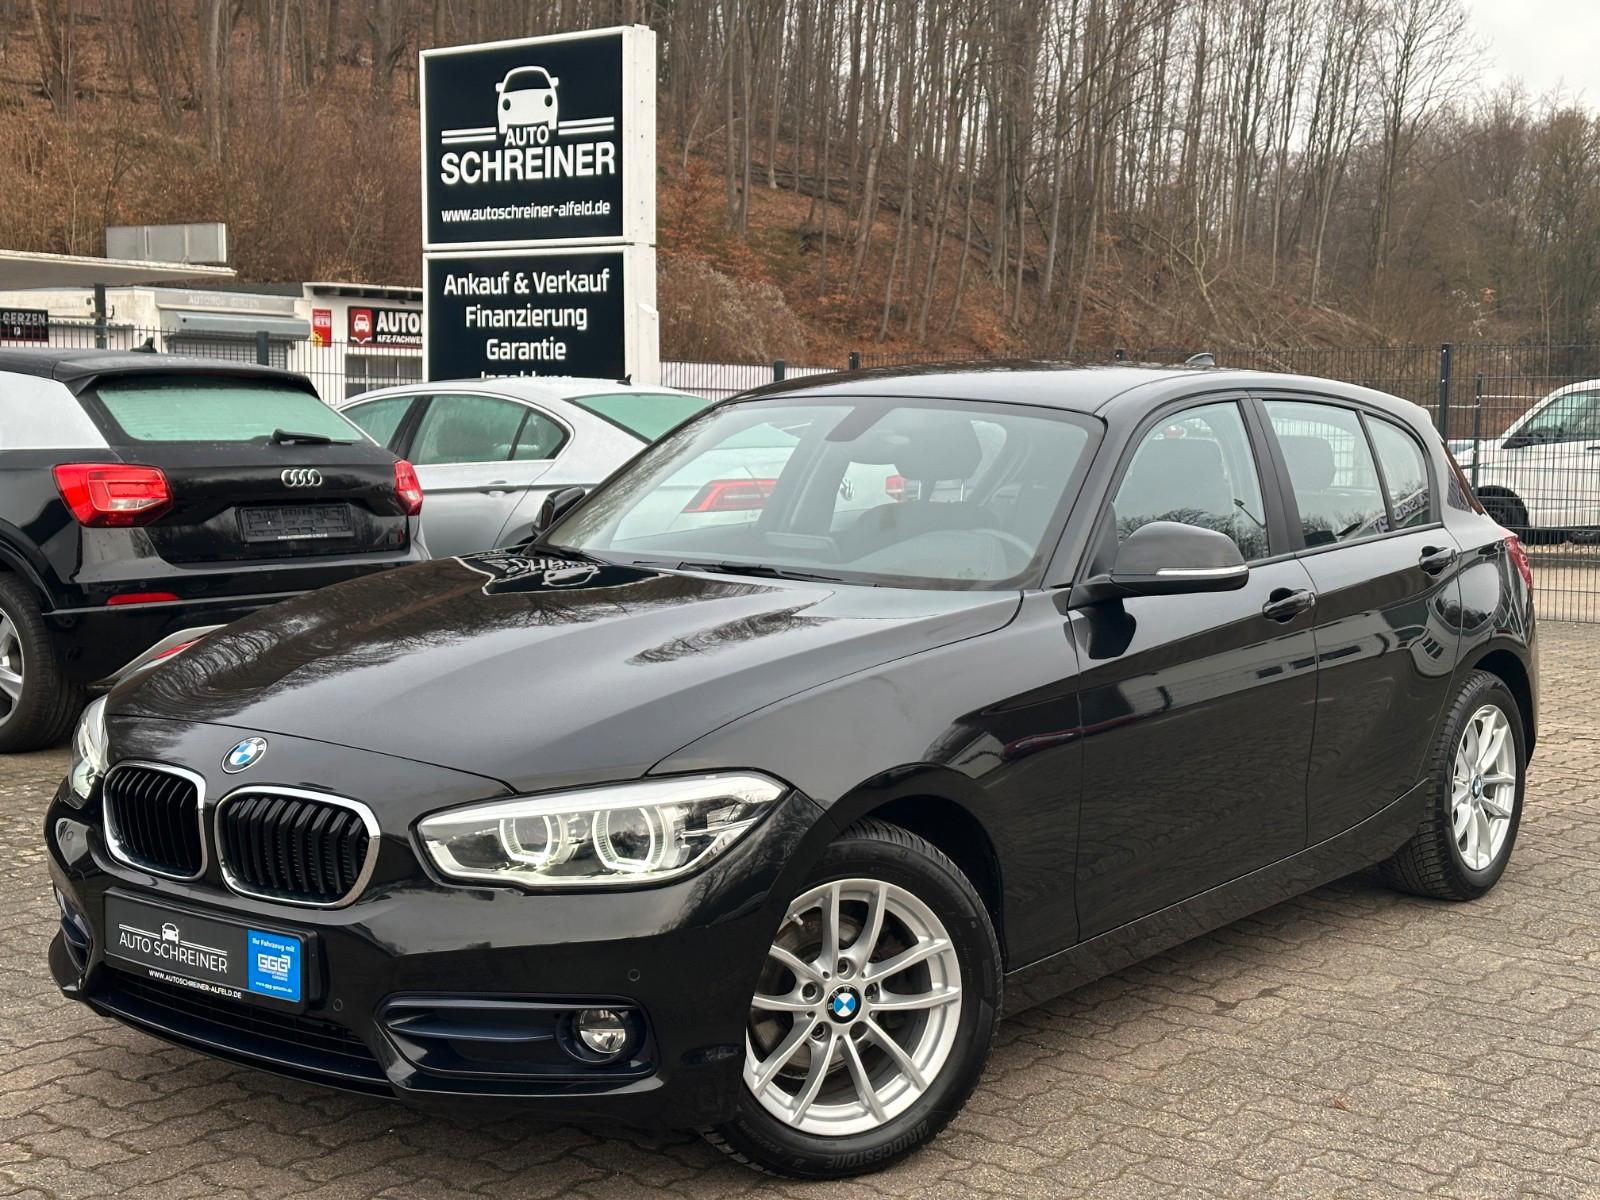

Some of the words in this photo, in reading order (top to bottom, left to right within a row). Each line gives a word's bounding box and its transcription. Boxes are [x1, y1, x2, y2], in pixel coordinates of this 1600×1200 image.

[504, 124, 550, 147] AUTO
[440, 140, 616, 186] SCHREINER
[441, 200, 611, 223] www.autoschreiner-alfeld.de
[443, 270, 510, 296] Ankauf
[513, 270, 530, 295] &
[532, 268, 610, 294] Verkauf
[2, 311, 46, 326] GERZEN
[376, 310, 423, 334] AUTO
[465, 304, 588, 332] Finanzierung
[376, 334, 423, 345] KFZ-FACHWE
[486, 338, 567, 361] Garantie
[119, 931, 152, 954] AUTO
[153, 942, 228, 974] SCHREINER
[257, 953, 291, 973] GGG
[148, 968, 242, 1000] WWW.AUTOSCHREINER-ALFELD.DE
